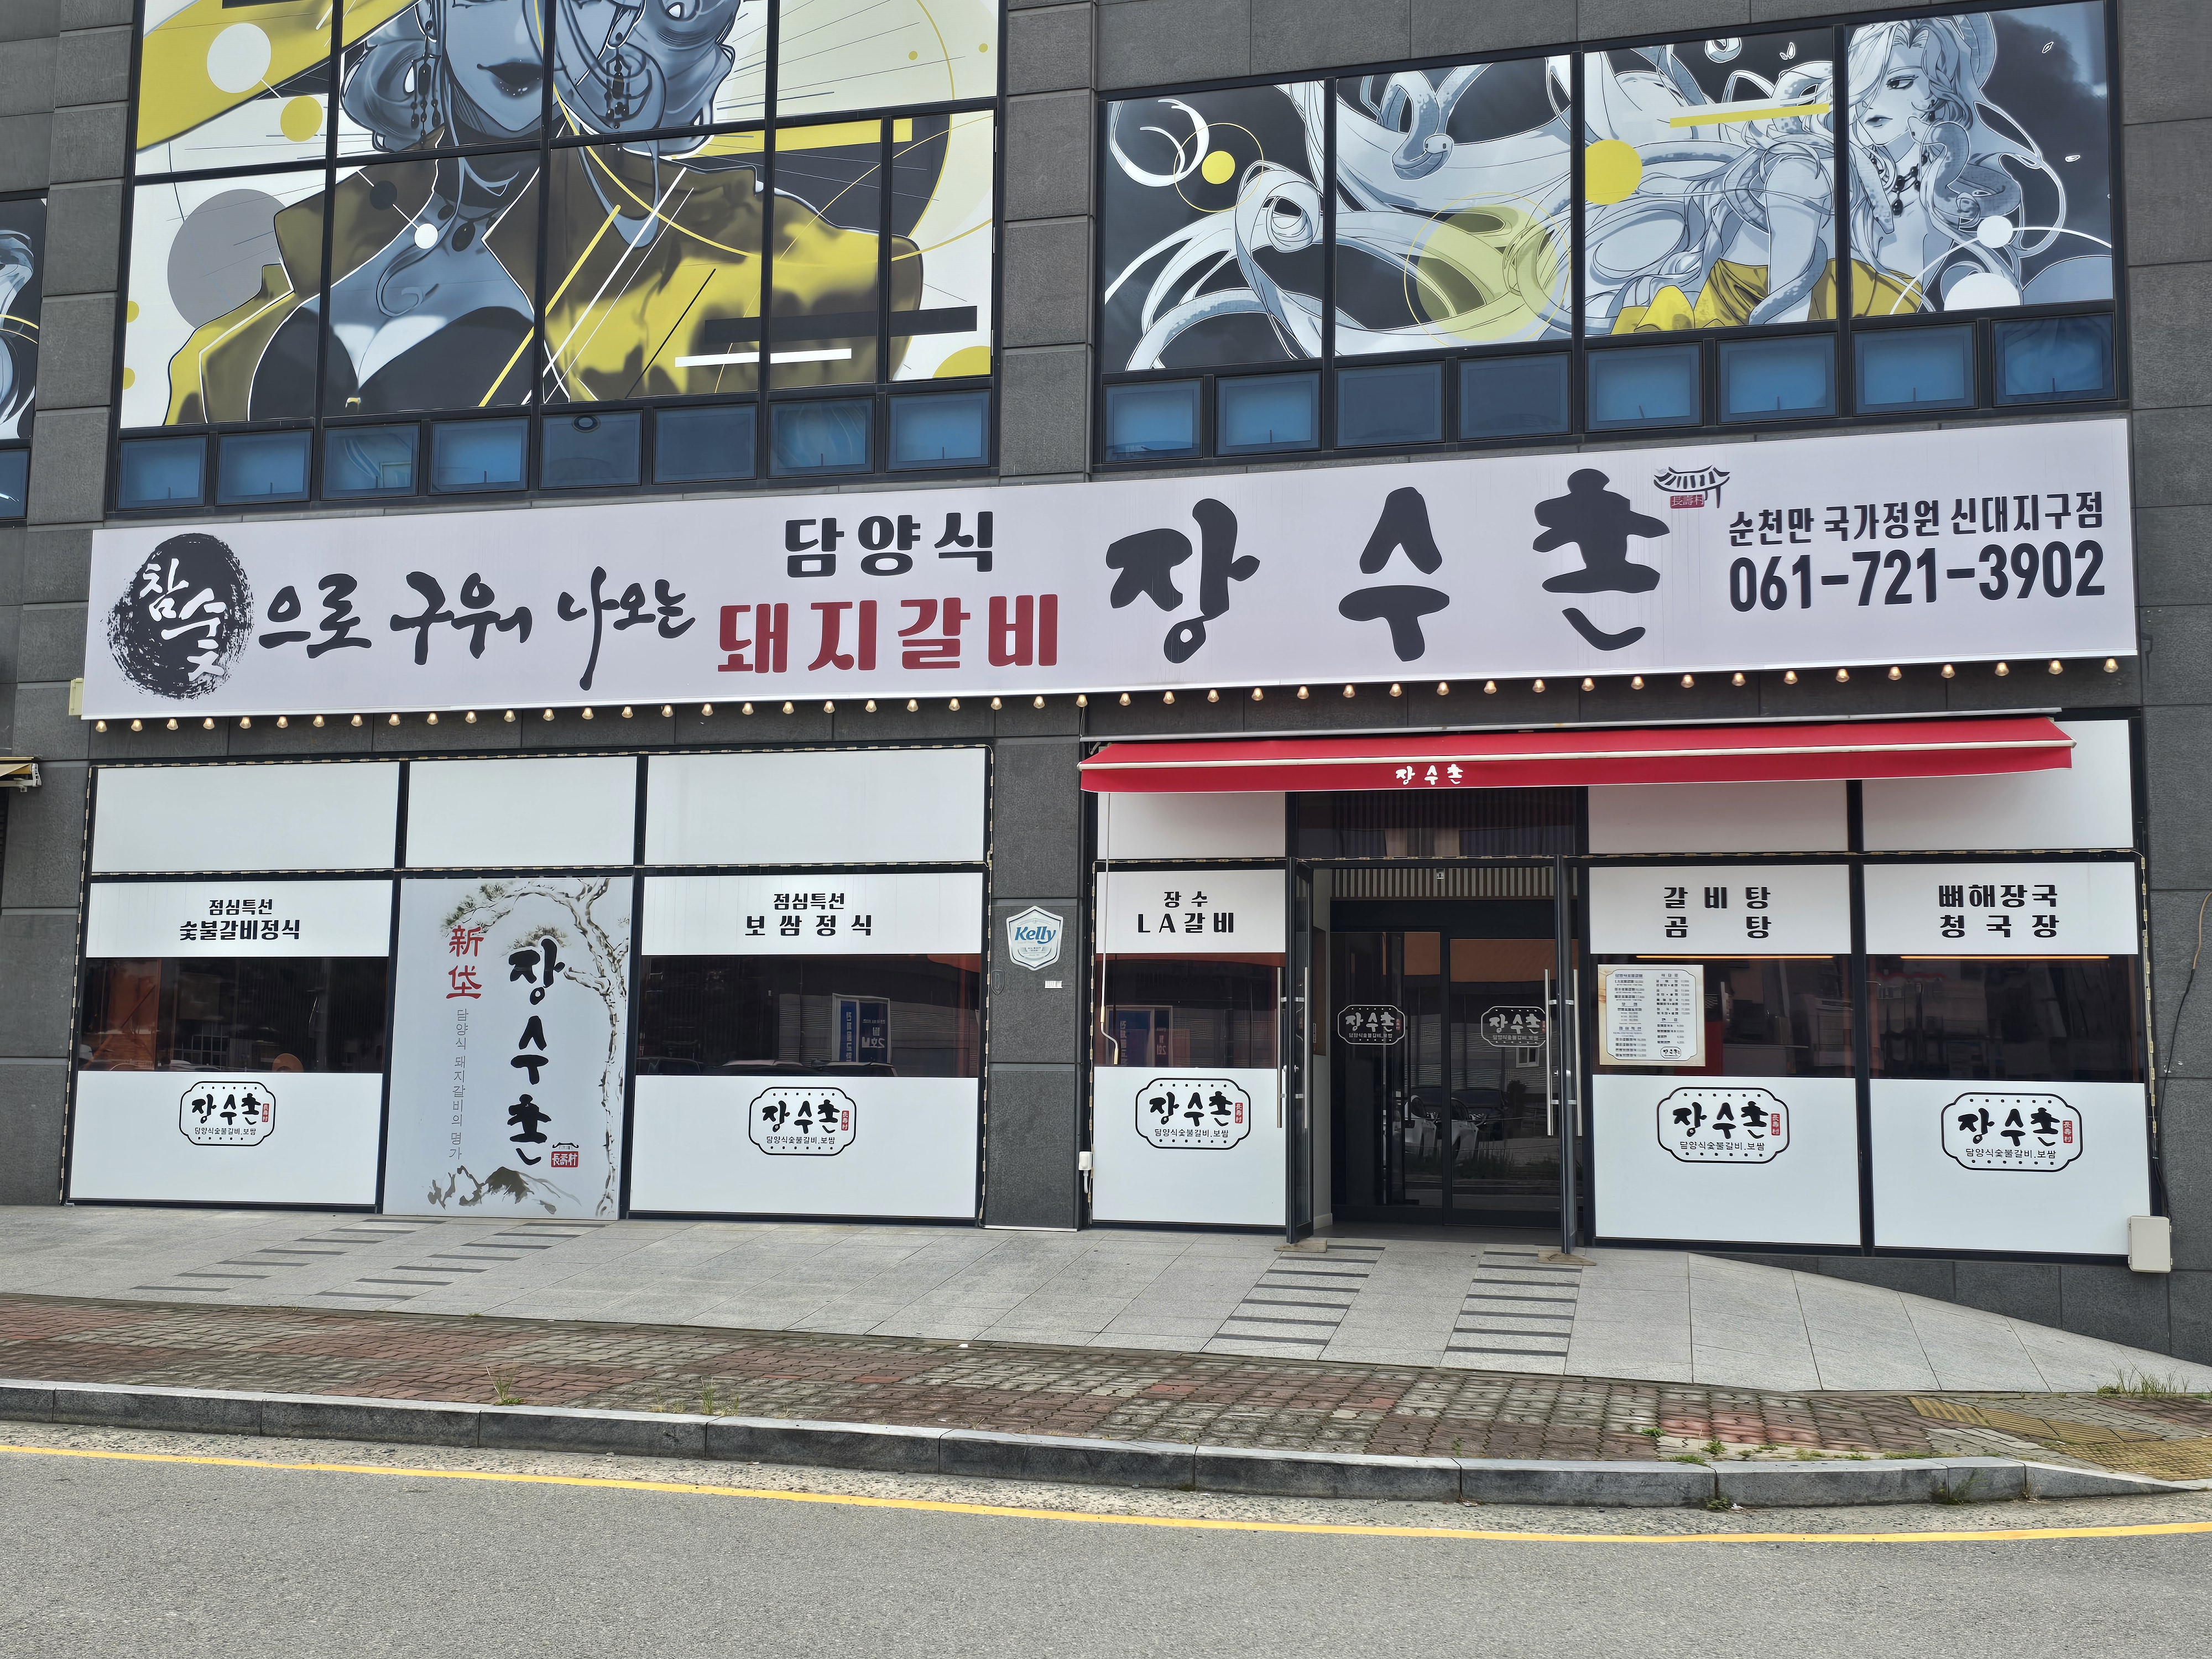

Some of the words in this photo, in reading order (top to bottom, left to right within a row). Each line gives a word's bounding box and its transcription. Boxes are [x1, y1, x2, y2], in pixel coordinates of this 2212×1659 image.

[1729, 508, 1814, 546] 순천만
[1824, 500, 1939, 541] 국가정원
[1951, 492, 2102, 534] 신대지구점
[785, 512, 993, 577] 담양식
[1107, 468, 1670, 664] 장수촌
[1730, 540, 2104, 612] 061-721-3902
[557, 566, 695, 691] 나오는
[718, 594, 1057, 673] 돼지갈비
[1396, 764, 1463, 785] 장수촌
[209, 899, 272, 915] 점심특선
[774, 893, 844, 910] 점심특선
[1164, 891, 1207, 907] 장수
[1939, 885, 2057, 907] 뼈해장국
[180, 920, 299, 940] 숯불갈비정식
[1015, 927, 1056, 944] Kelly
[1940, 915, 2059, 938] 청국장
[456, 1009, 468, 1050] 담양식
[1345, 1012, 1395, 1032] 장수촌
[1489, 1014, 1541, 1034] 장수촌
[508, 938, 565, 1165] 장수촌
[452, 1056, 465, 1126] 돼지갈비의
[1150, 1091, 1233, 1126] 장수촌
[192, 1093, 261, 1125] 장수촌
[763, 1099, 839, 1134] 장수촌
[1673, 1101, 1768, 1139] 장수촌
[1958, 1108, 2060, 1146] 장수촌
[449, 1133, 462, 1160] 명가
